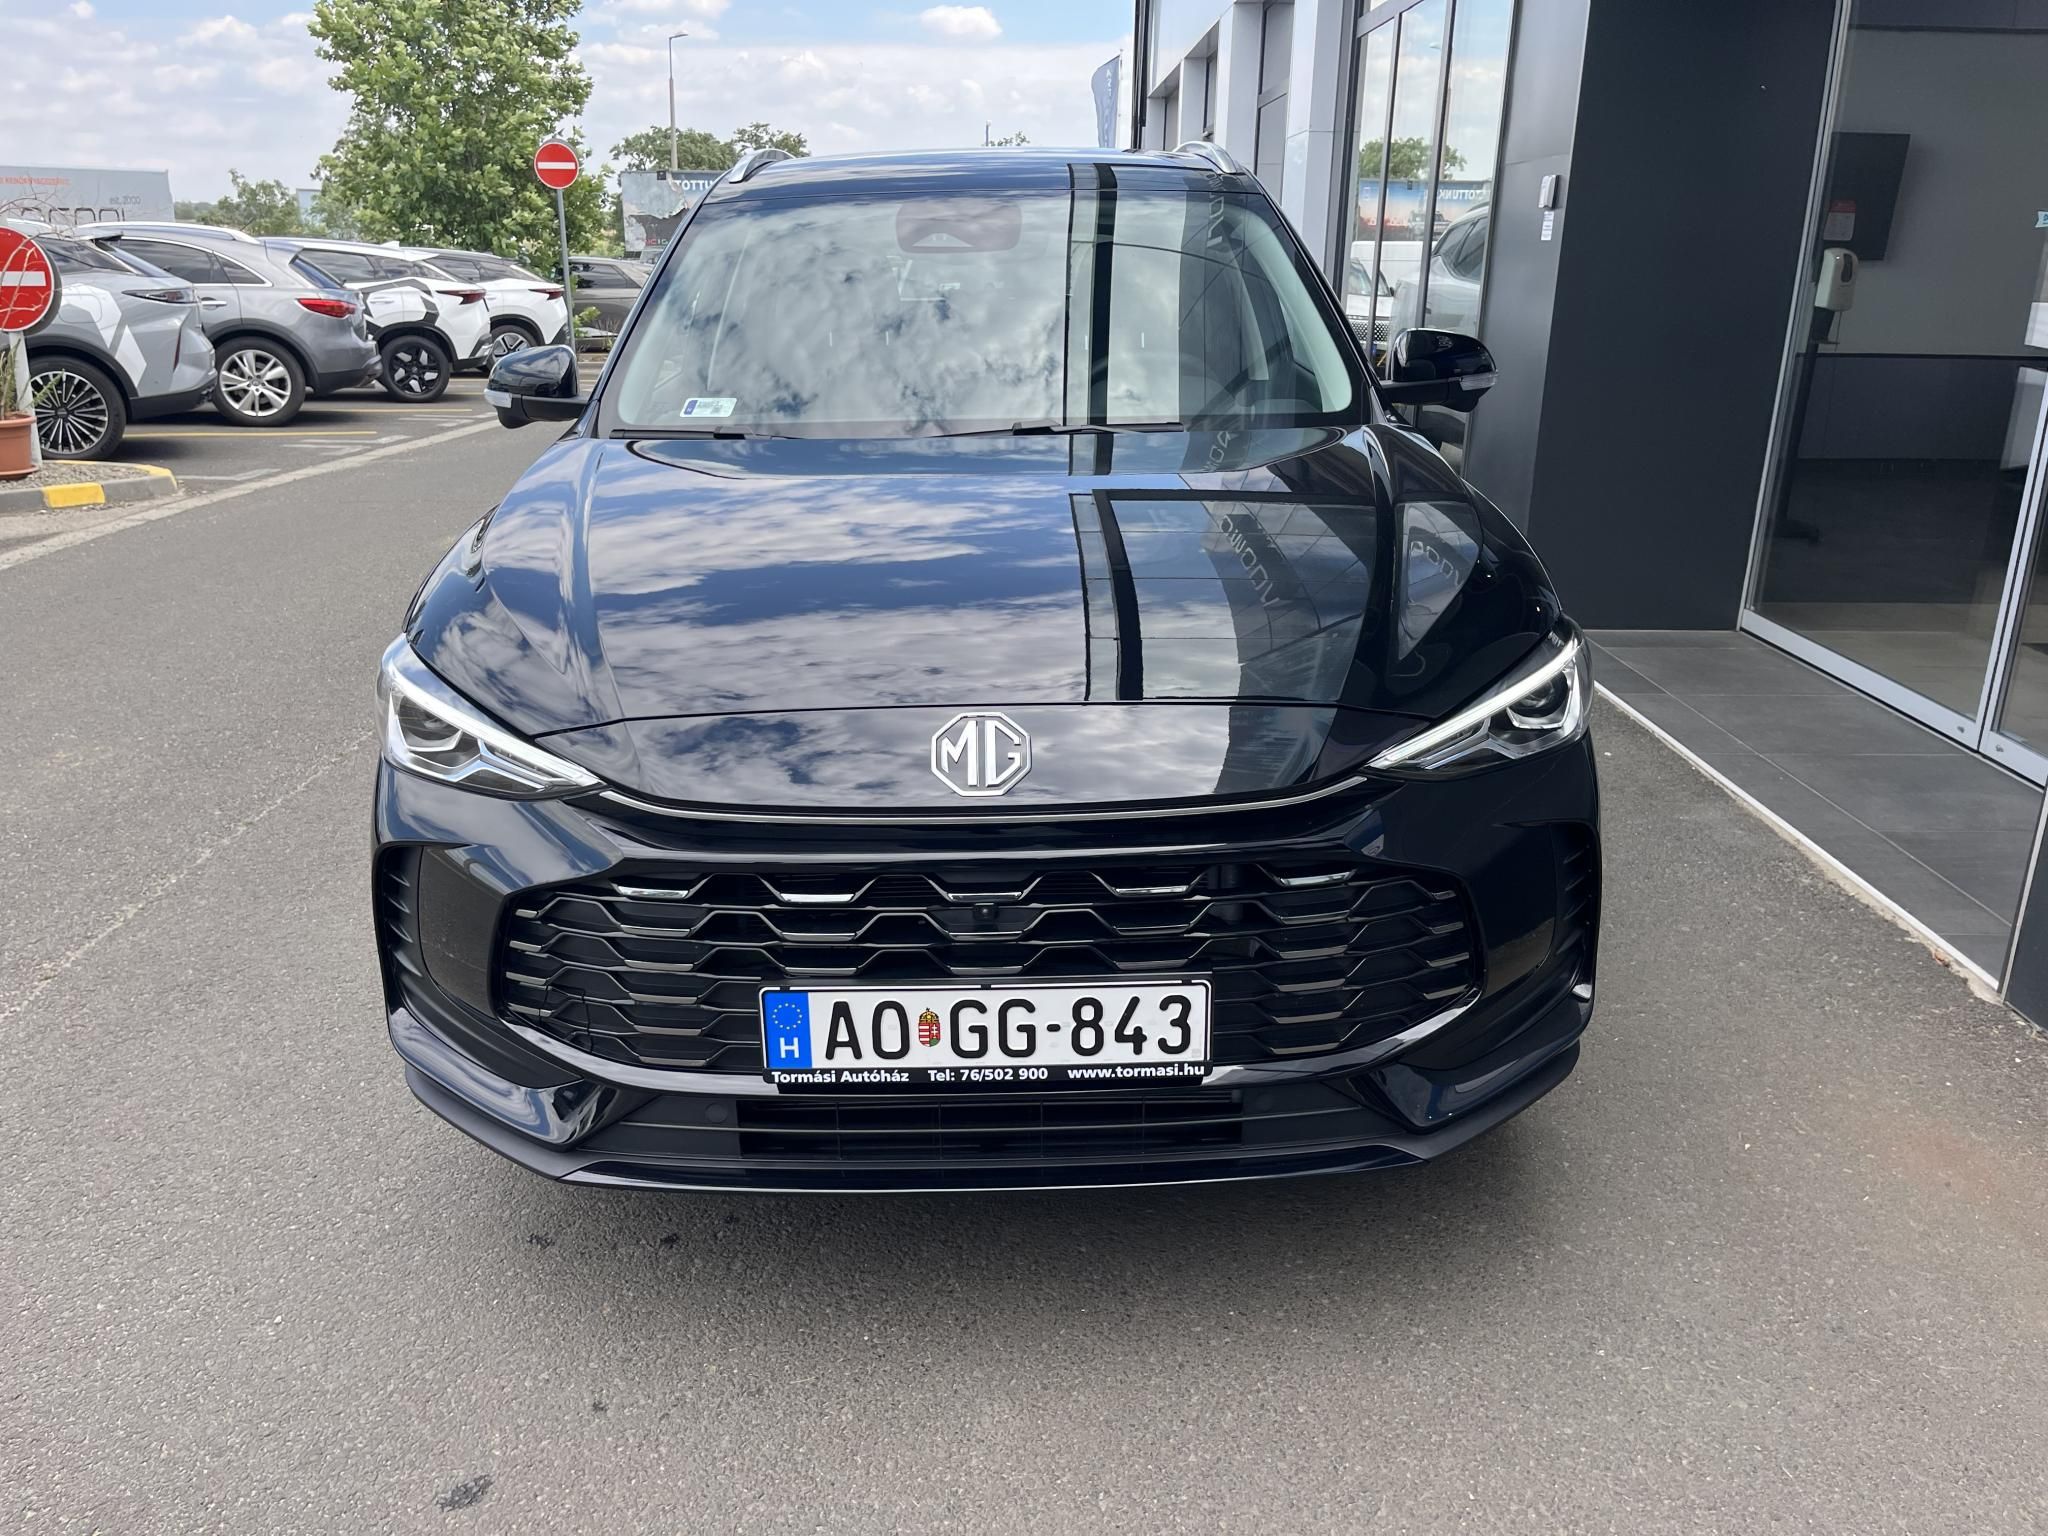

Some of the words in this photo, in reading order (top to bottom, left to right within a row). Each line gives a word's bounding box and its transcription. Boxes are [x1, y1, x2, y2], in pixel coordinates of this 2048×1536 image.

[673, 180, 713, 191] TOTTU
[940, 720, 1022, 788] MG
[825, 1000, 910, 1060] AO
[949, 995, 1192, 1059] GG-843
[780, 1037, 800, 1059] H
[772, 1071, 836, 1083] Tormási
[840, 1070, 909, 1083] Autóház
[928, 1069, 956, 1082] Tel:
[959, 1069, 1014, 1083] 76/502
[1018, 1068, 1048, 1080] 900
[1068, 1064, 1205, 1080] www.tormasi.hu
